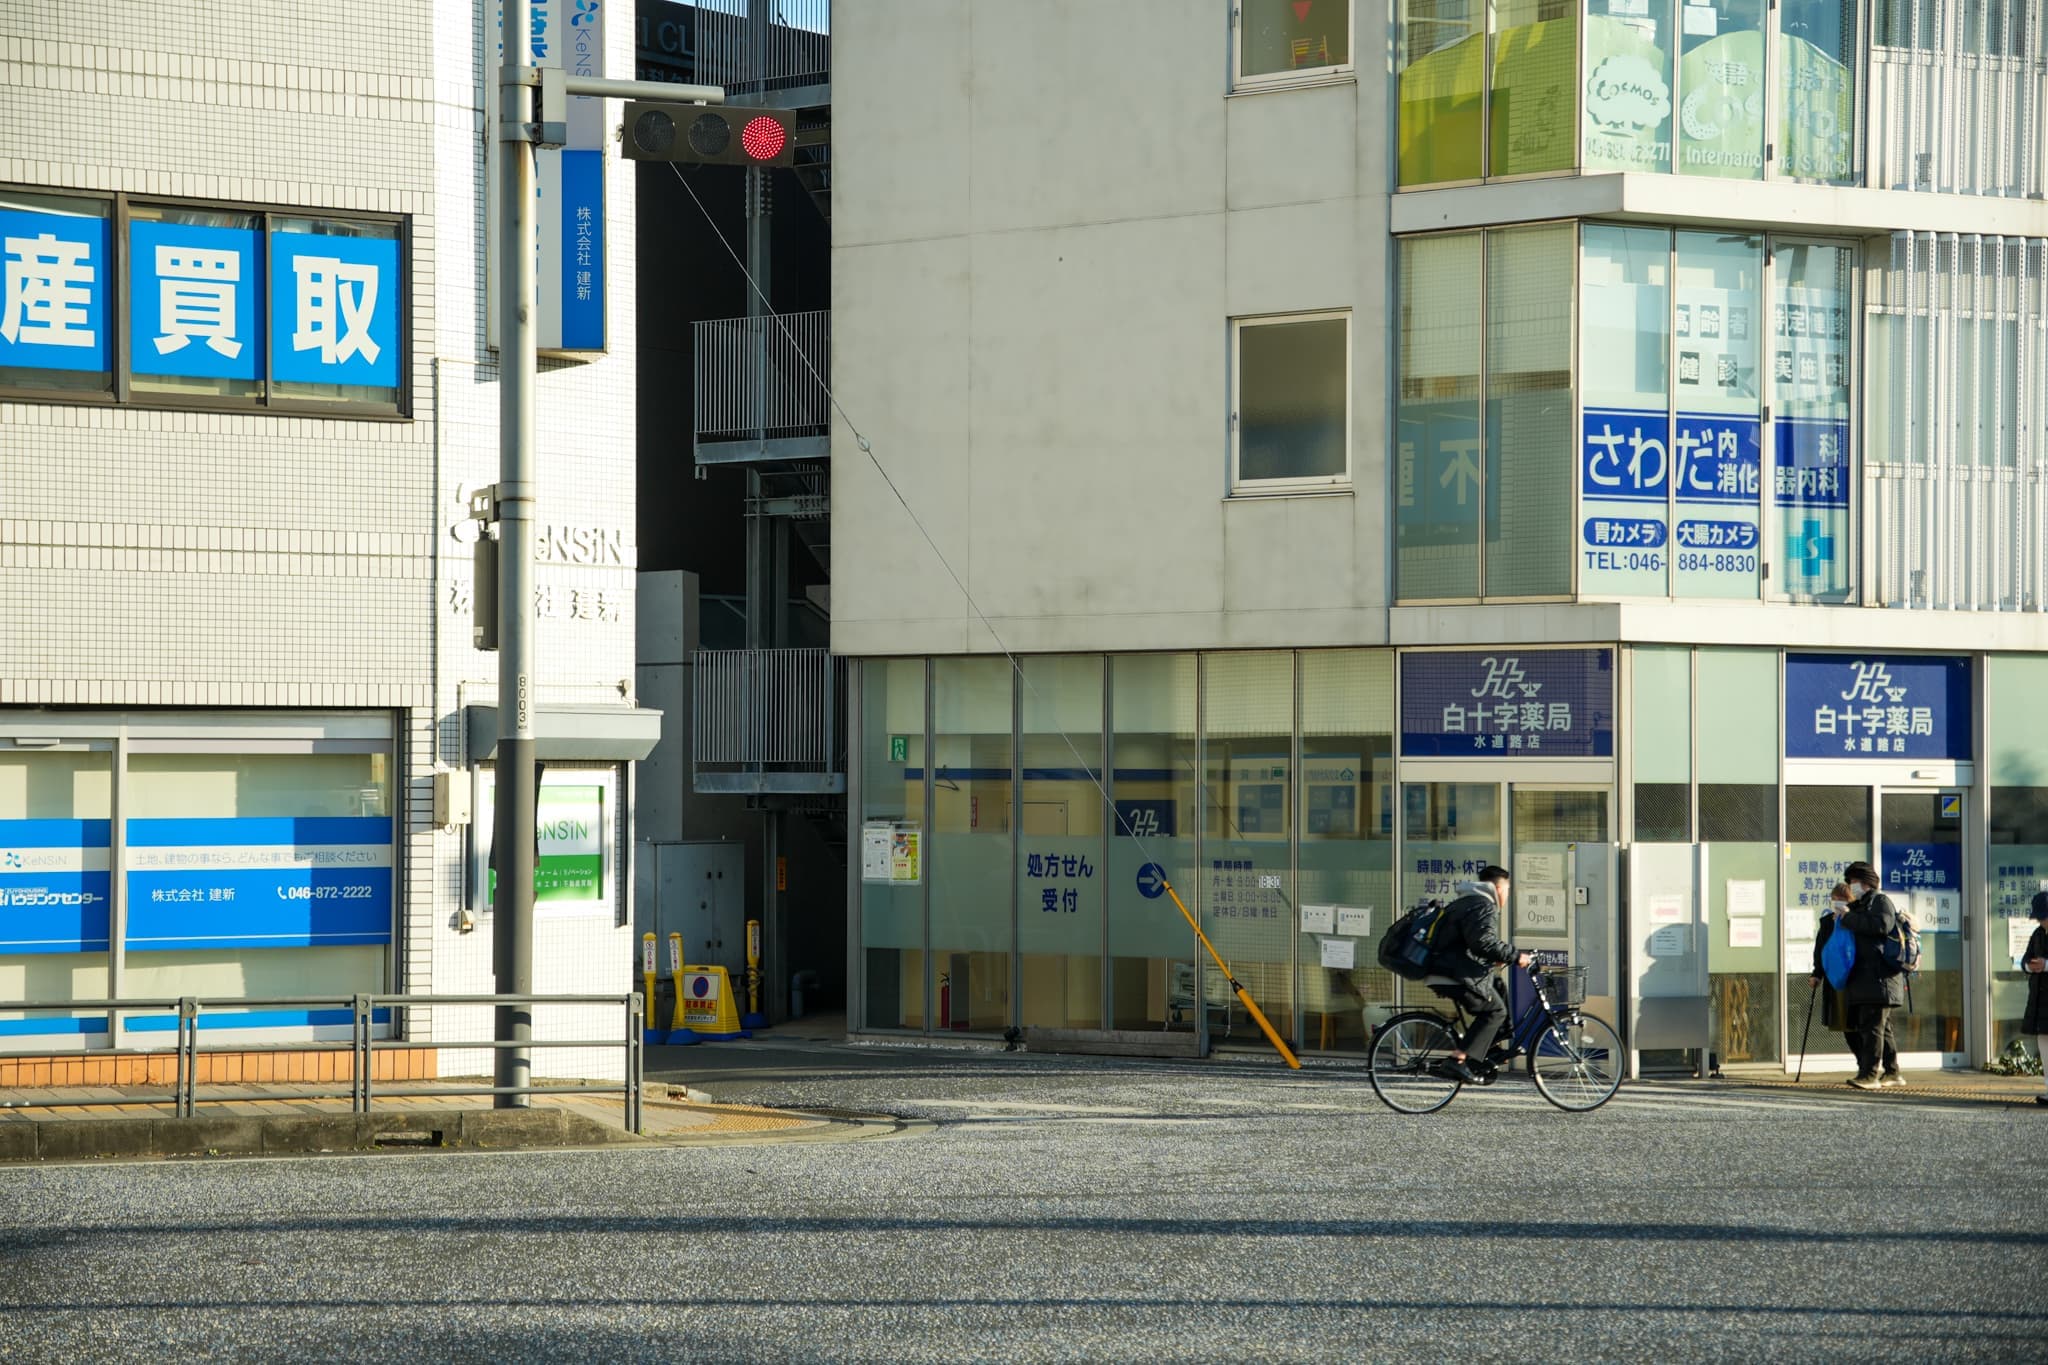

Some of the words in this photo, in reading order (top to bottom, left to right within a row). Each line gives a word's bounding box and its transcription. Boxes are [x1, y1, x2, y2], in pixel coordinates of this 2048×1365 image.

[575, 29, 592, 99] KeNS
[576, 206, 592, 266] 株式会社
[576, 271, 592, 300] 建新
[0, 234, 381, 366] 産買取
[1680, 356, 1738, 383] 健診
[1586, 424, 1713, 490] さわだ
[1717, 462, 1839, 497] 消化器内科
[535, 525, 621, 564] eNSiN
[1594, 521, 1656, 544] 胃カメラ
[1678, 525, 1754, 546] 大腸カメラ
[1443, 702, 1572, 732] 白十字薬局
[1815, 704, 1933, 736] 白十字薬局
[1474, 734, 1541, 749] 水道路店
[1844, 737, 1905, 752] 水道路店
[1027, 853, 1093, 878] 処方せん
[1890, 870, 1945, 884] 白十字薬局
[152, 888, 204, 903] 株式会社
[209, 887, 235, 902] 建新
[288, 886, 372, 900] 046-872-2222
[1042, 888, 1079, 913] 受付
[1527, 910, 1555, 924] Open
[1925, 914, 1950, 926] Open
